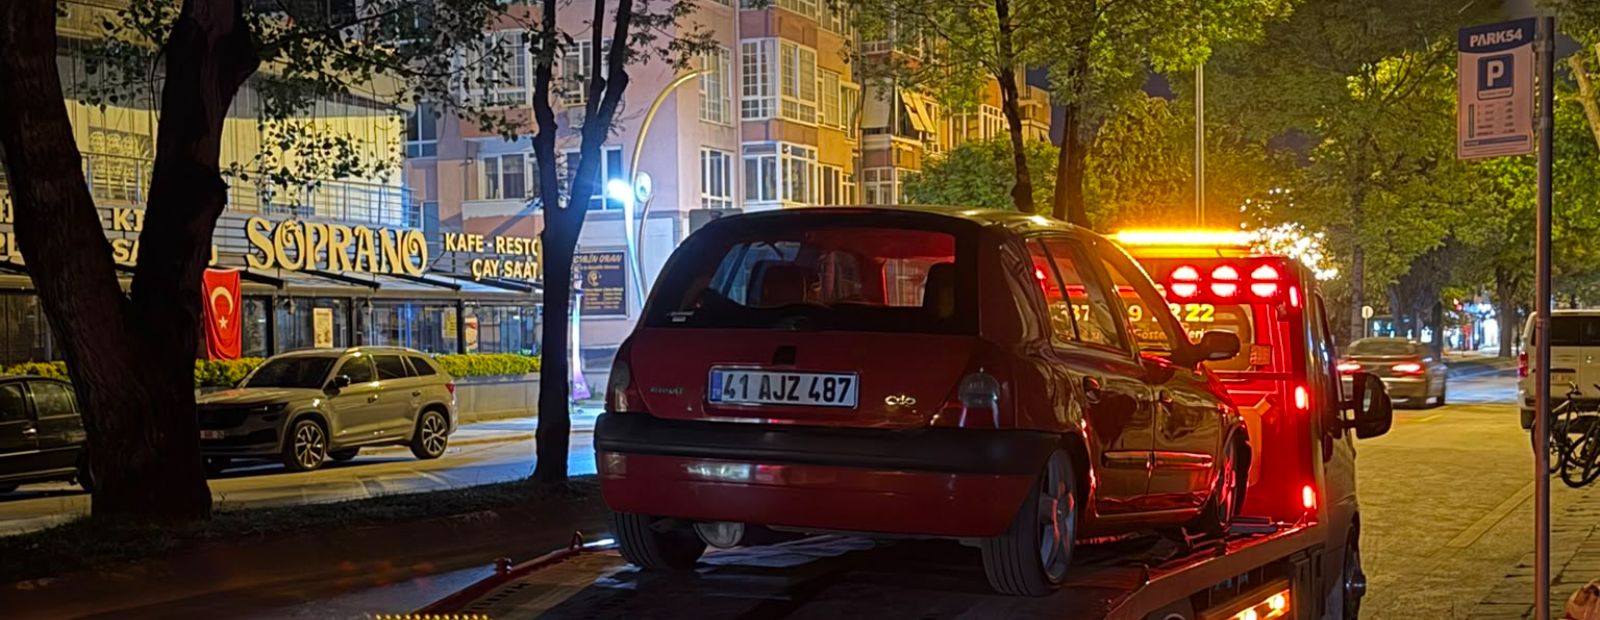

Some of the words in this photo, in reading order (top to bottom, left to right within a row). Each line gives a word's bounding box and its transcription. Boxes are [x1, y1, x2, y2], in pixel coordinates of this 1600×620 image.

[1469, 28, 1523, 48] PARK54
[1487, 60, 1504, 87] P
[445, 232, 484, 253] KAFE
[472, 258, 499, 281] ÇAY
[1185, 303, 1215, 322] 22
[723, 374, 748, 399] 41
[759, 375, 800, 401] AJZ
[808, 376, 851, 403] 487
